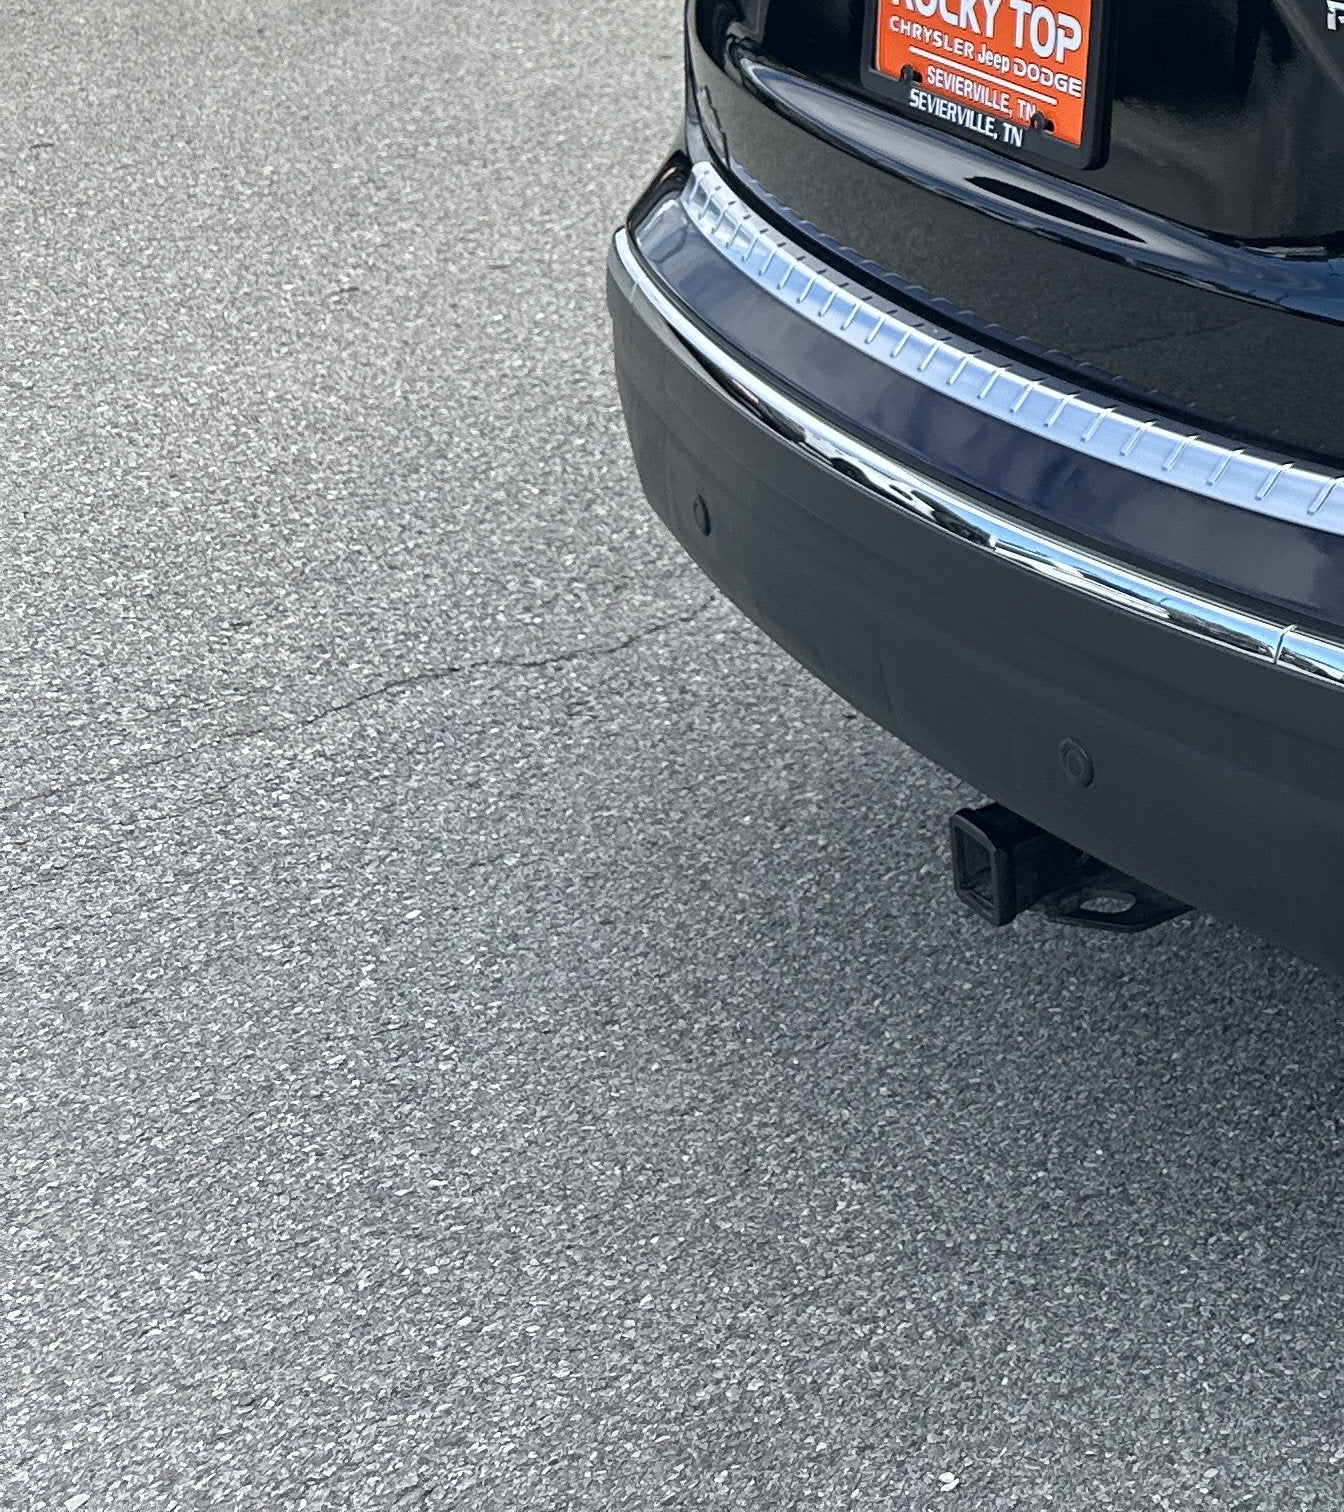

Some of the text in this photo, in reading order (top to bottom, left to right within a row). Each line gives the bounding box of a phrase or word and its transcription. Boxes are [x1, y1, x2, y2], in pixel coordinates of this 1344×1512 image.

[888, 15, 1084, 98] CHRYSLER Jeep DODGE
[908, 88, 1024, 148] SEVIERVILLE, TN
[926, 65, 1038, 122] SEVIERVILLE, TN
